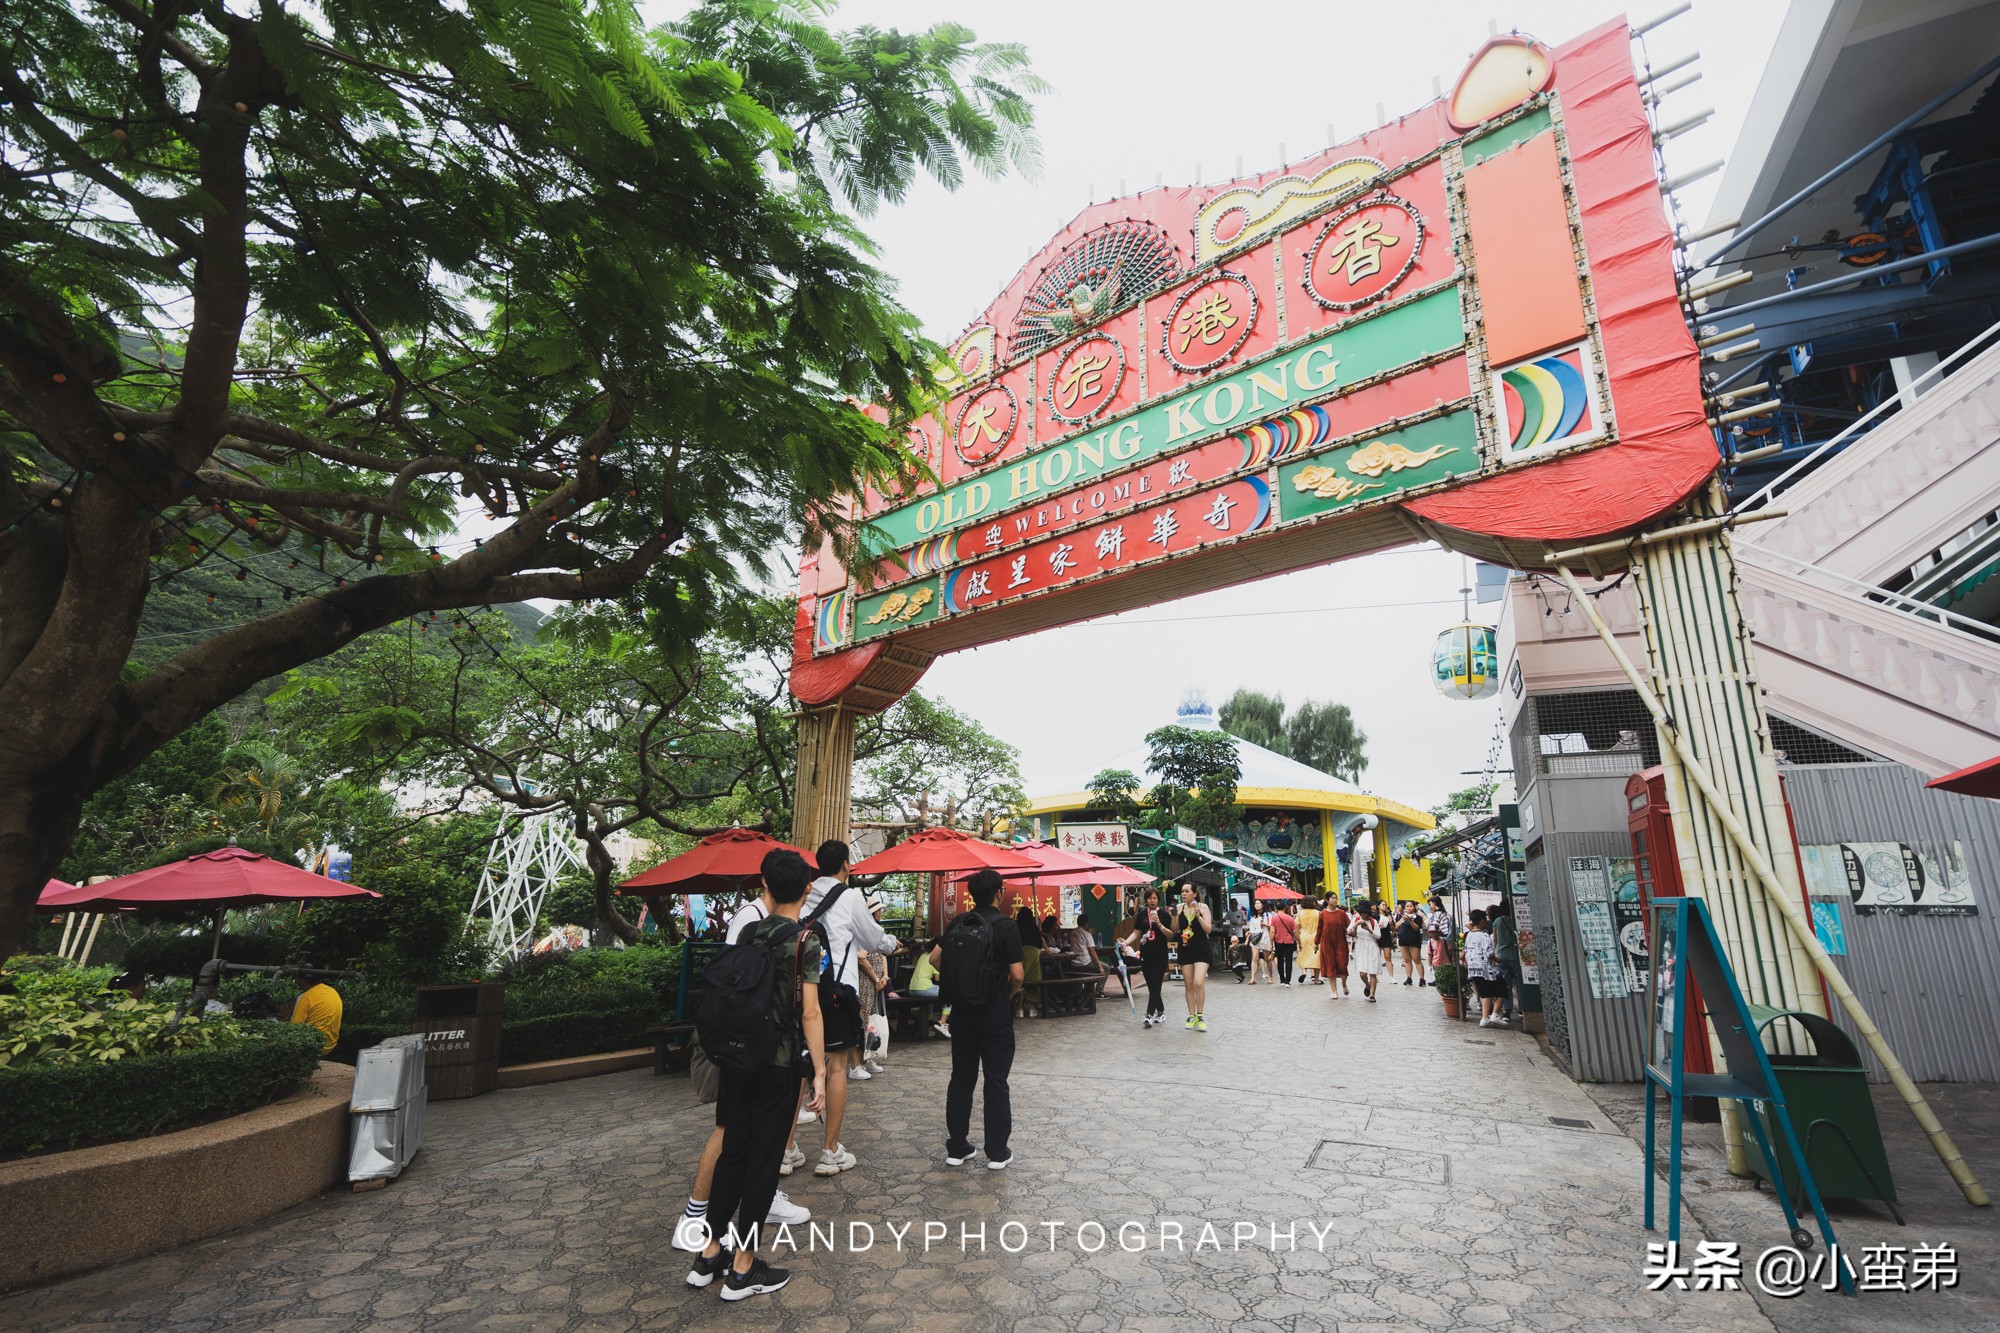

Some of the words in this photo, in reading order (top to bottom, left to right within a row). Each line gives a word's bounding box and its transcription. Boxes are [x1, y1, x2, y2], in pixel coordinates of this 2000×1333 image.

[914, 481, 992, 535] OLD
[1007, 419, 1143, 502] HONG
[1163, 343, 1341, 444] KONG
[1014, 473, 1153, 534] WELCOME
[424, 1030, 466, 1042] ITTER
